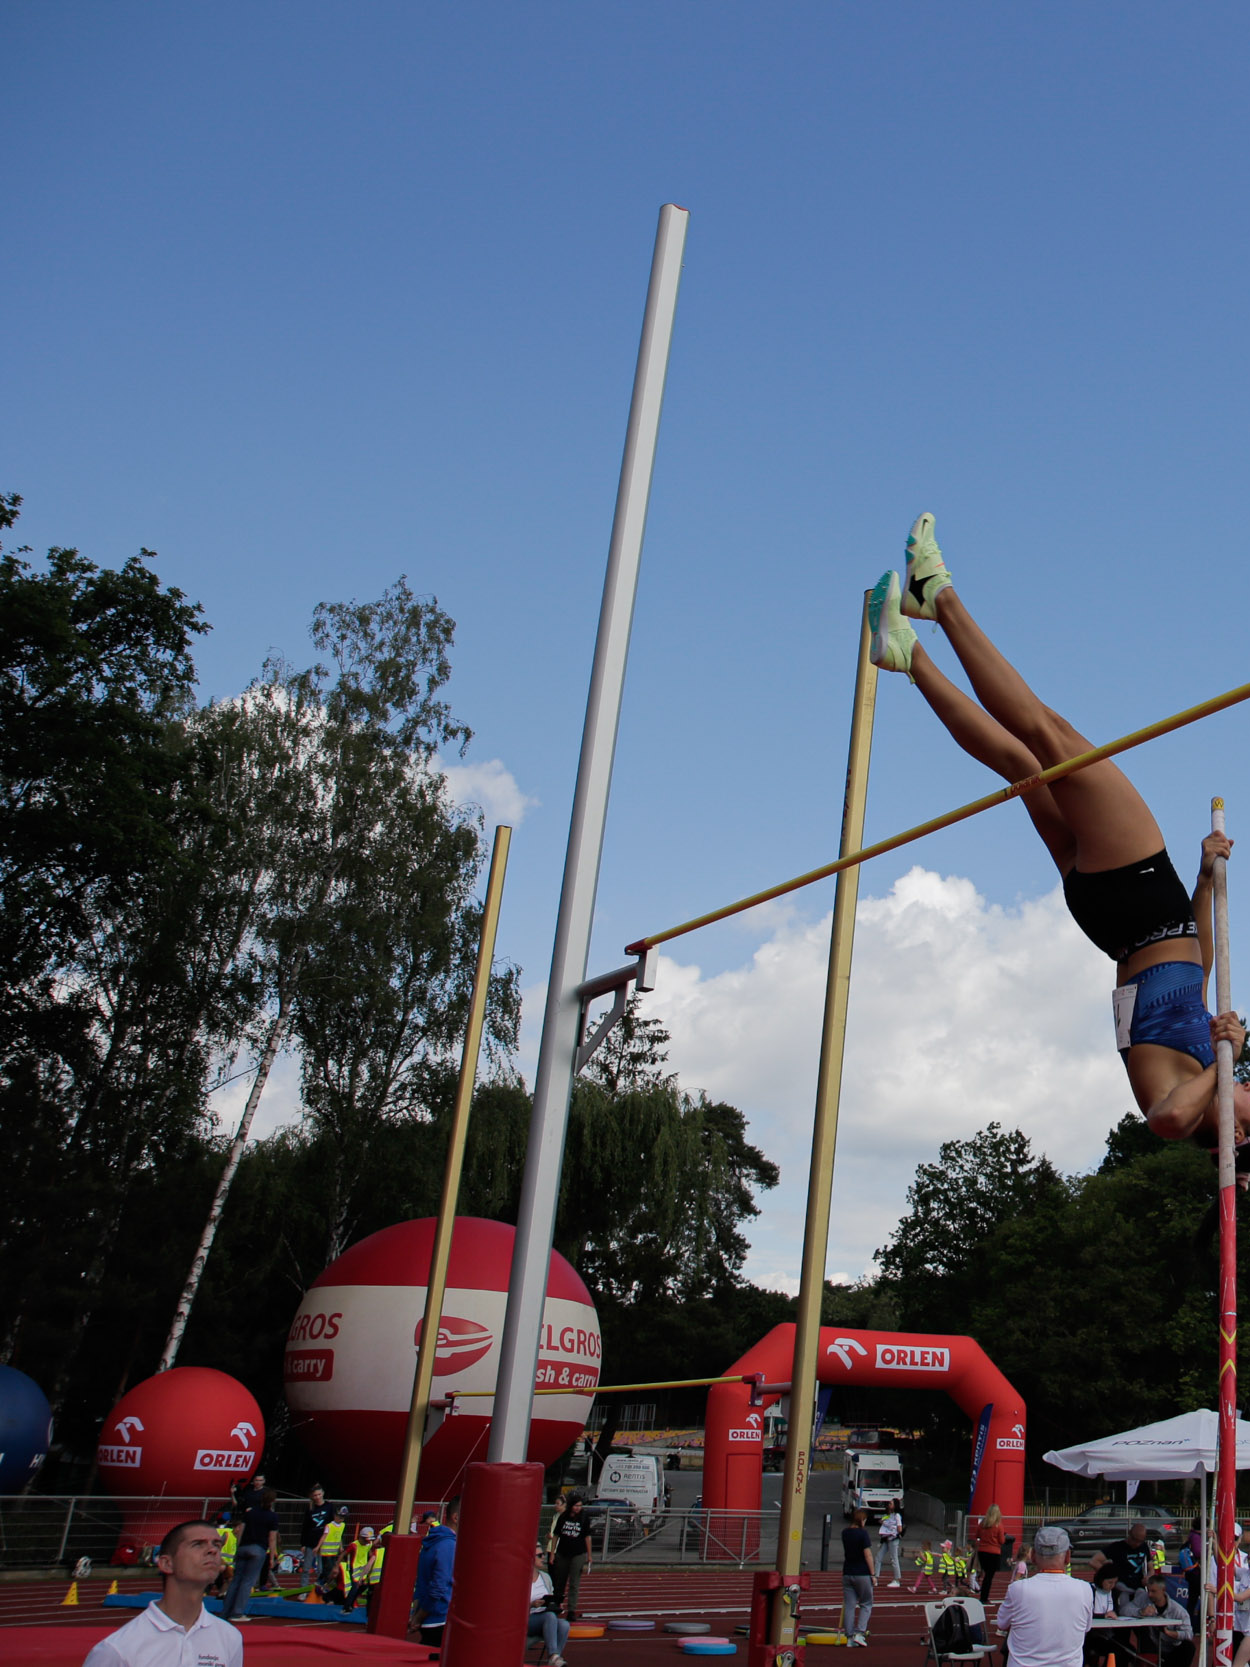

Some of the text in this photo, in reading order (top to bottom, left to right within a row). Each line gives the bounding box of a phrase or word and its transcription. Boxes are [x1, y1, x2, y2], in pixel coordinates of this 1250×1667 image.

[290, 1312, 343, 1341] GROS
[539, 1323, 601, 1359] LGROS
[292, 1358, 327, 1378] carry
[880, 1348, 945, 1368] ORLEN
[535, 1364, 597, 1388] sh & carry
[731, 1431, 760, 1440] ORLEN
[998, 1440, 1025, 1449] ORLEN
[98, 1448, 137, 1464] ORLEN
[199, 1452, 252, 1469] ORLEN
[795, 1451, 805, 1494] POLANIK
